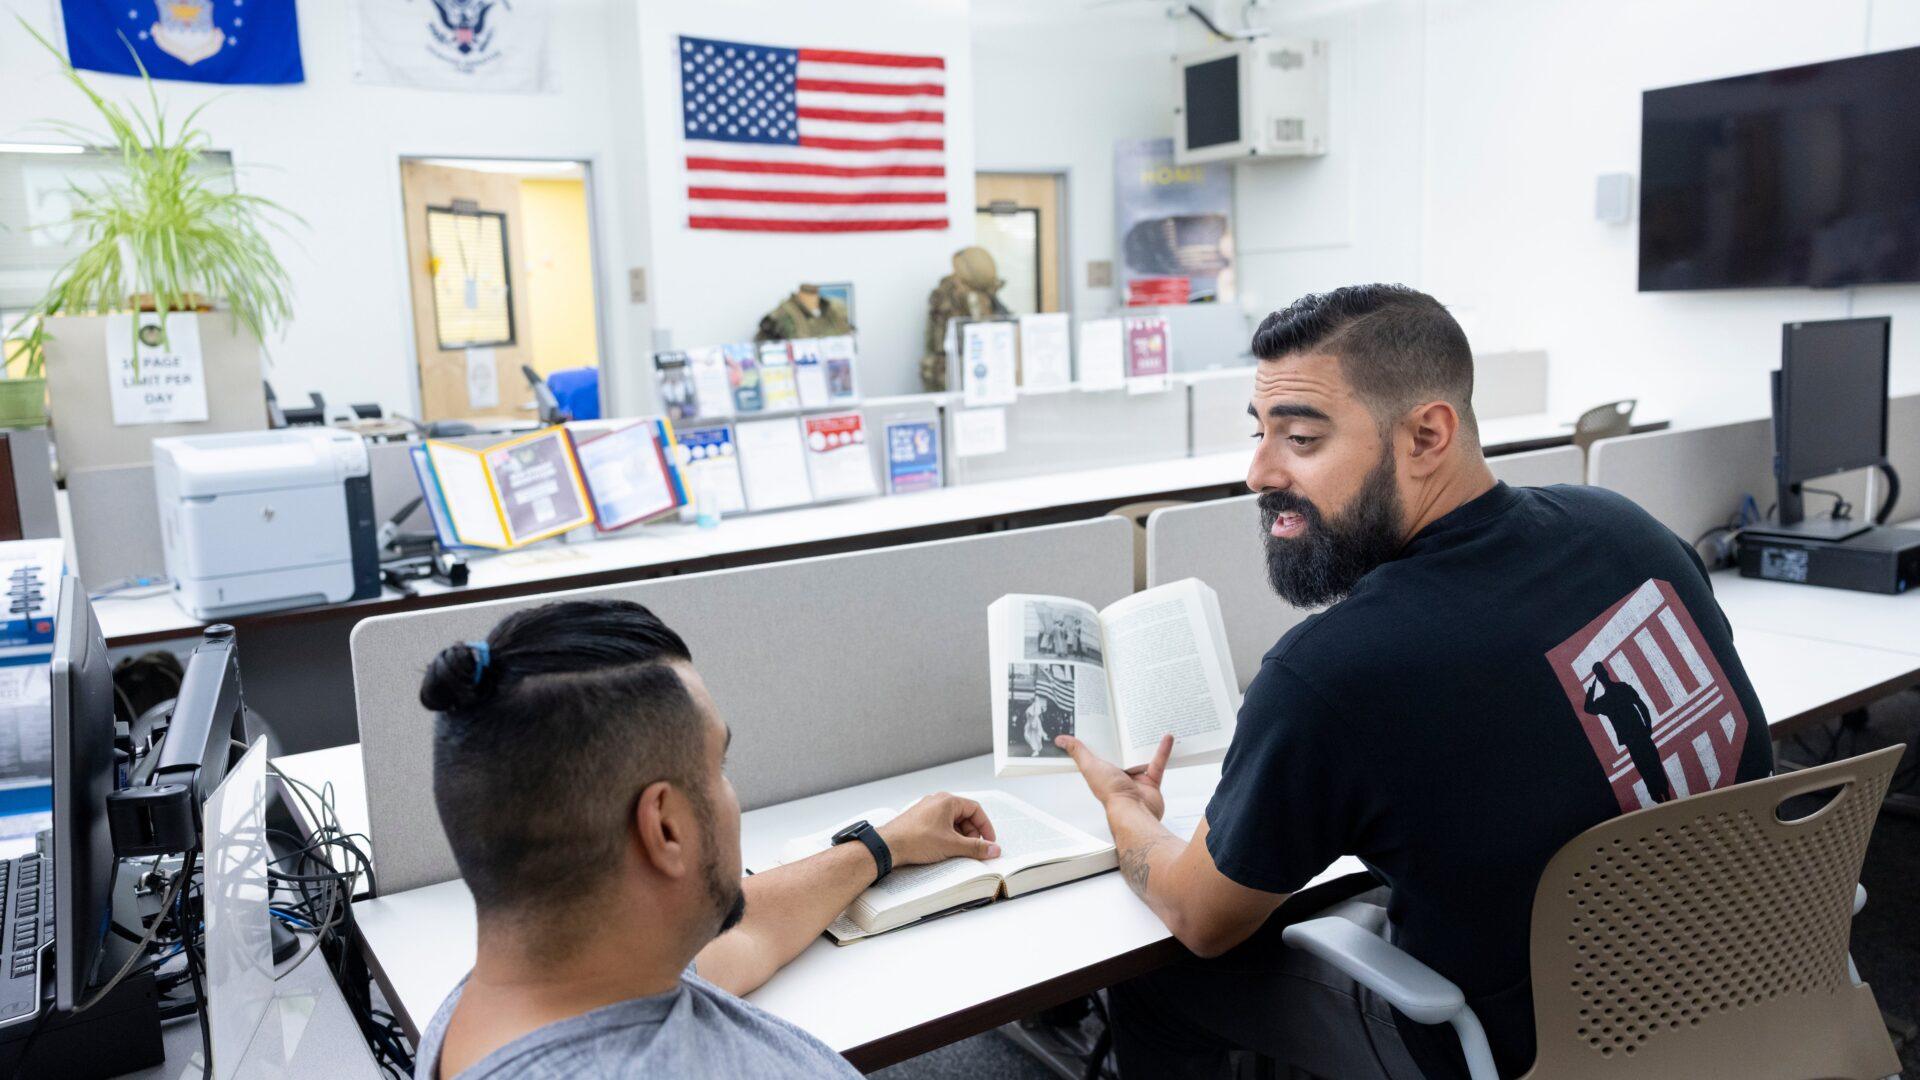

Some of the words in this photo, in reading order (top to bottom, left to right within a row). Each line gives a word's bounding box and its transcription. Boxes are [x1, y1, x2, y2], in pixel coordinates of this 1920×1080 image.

[144, 356, 181, 368] PAGE
[165, 373, 192, 386] PER
[144, 393, 173, 404] DAY
